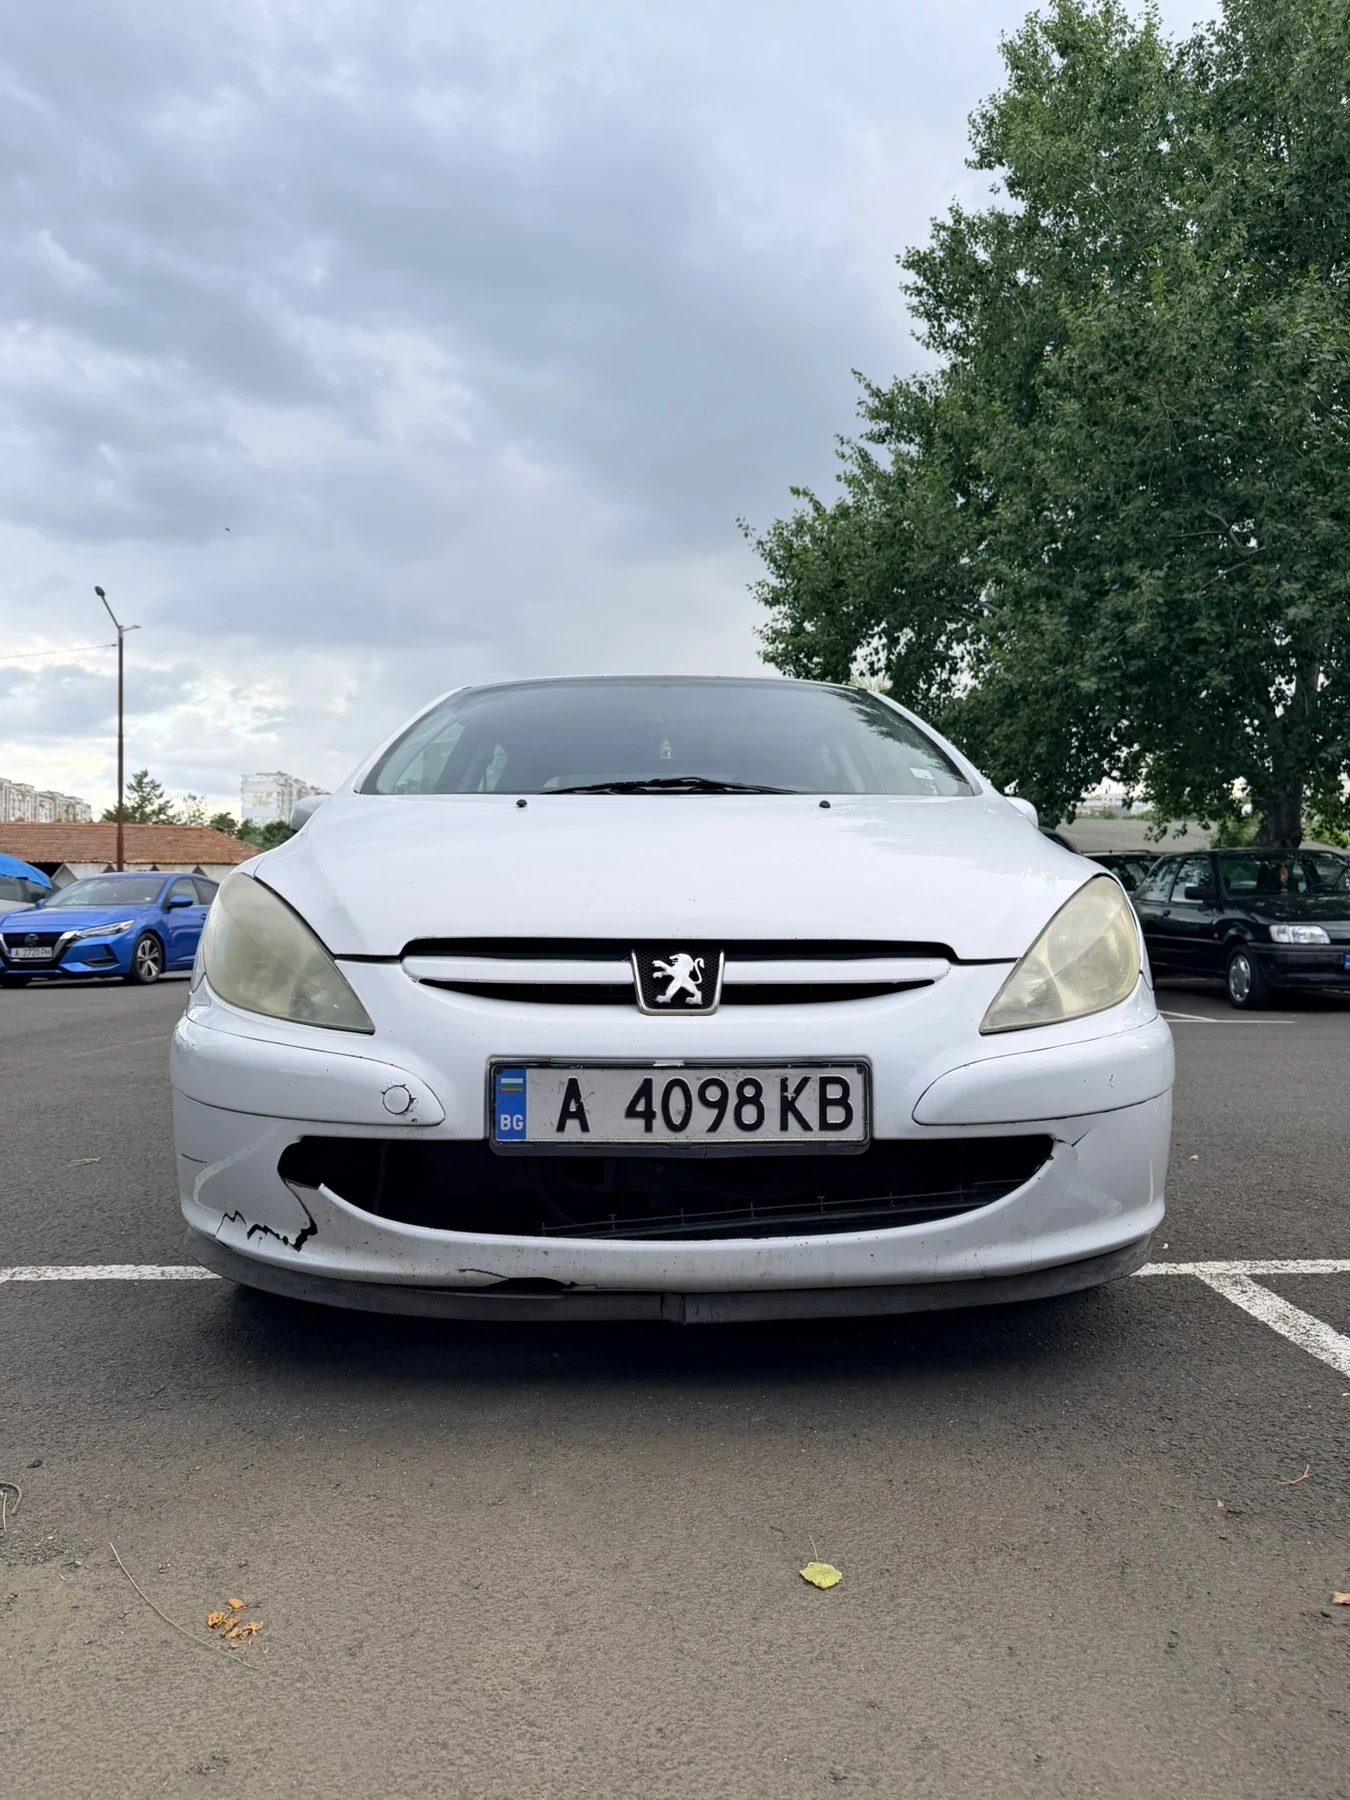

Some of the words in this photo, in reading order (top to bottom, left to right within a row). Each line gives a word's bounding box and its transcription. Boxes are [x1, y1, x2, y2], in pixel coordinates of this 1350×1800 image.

[556, 1077, 590, 1132] A
[625, 1077, 765, 1132] 4098
[780, 1077, 854, 1132] KB
[500, 1115, 524, 1130] BG
